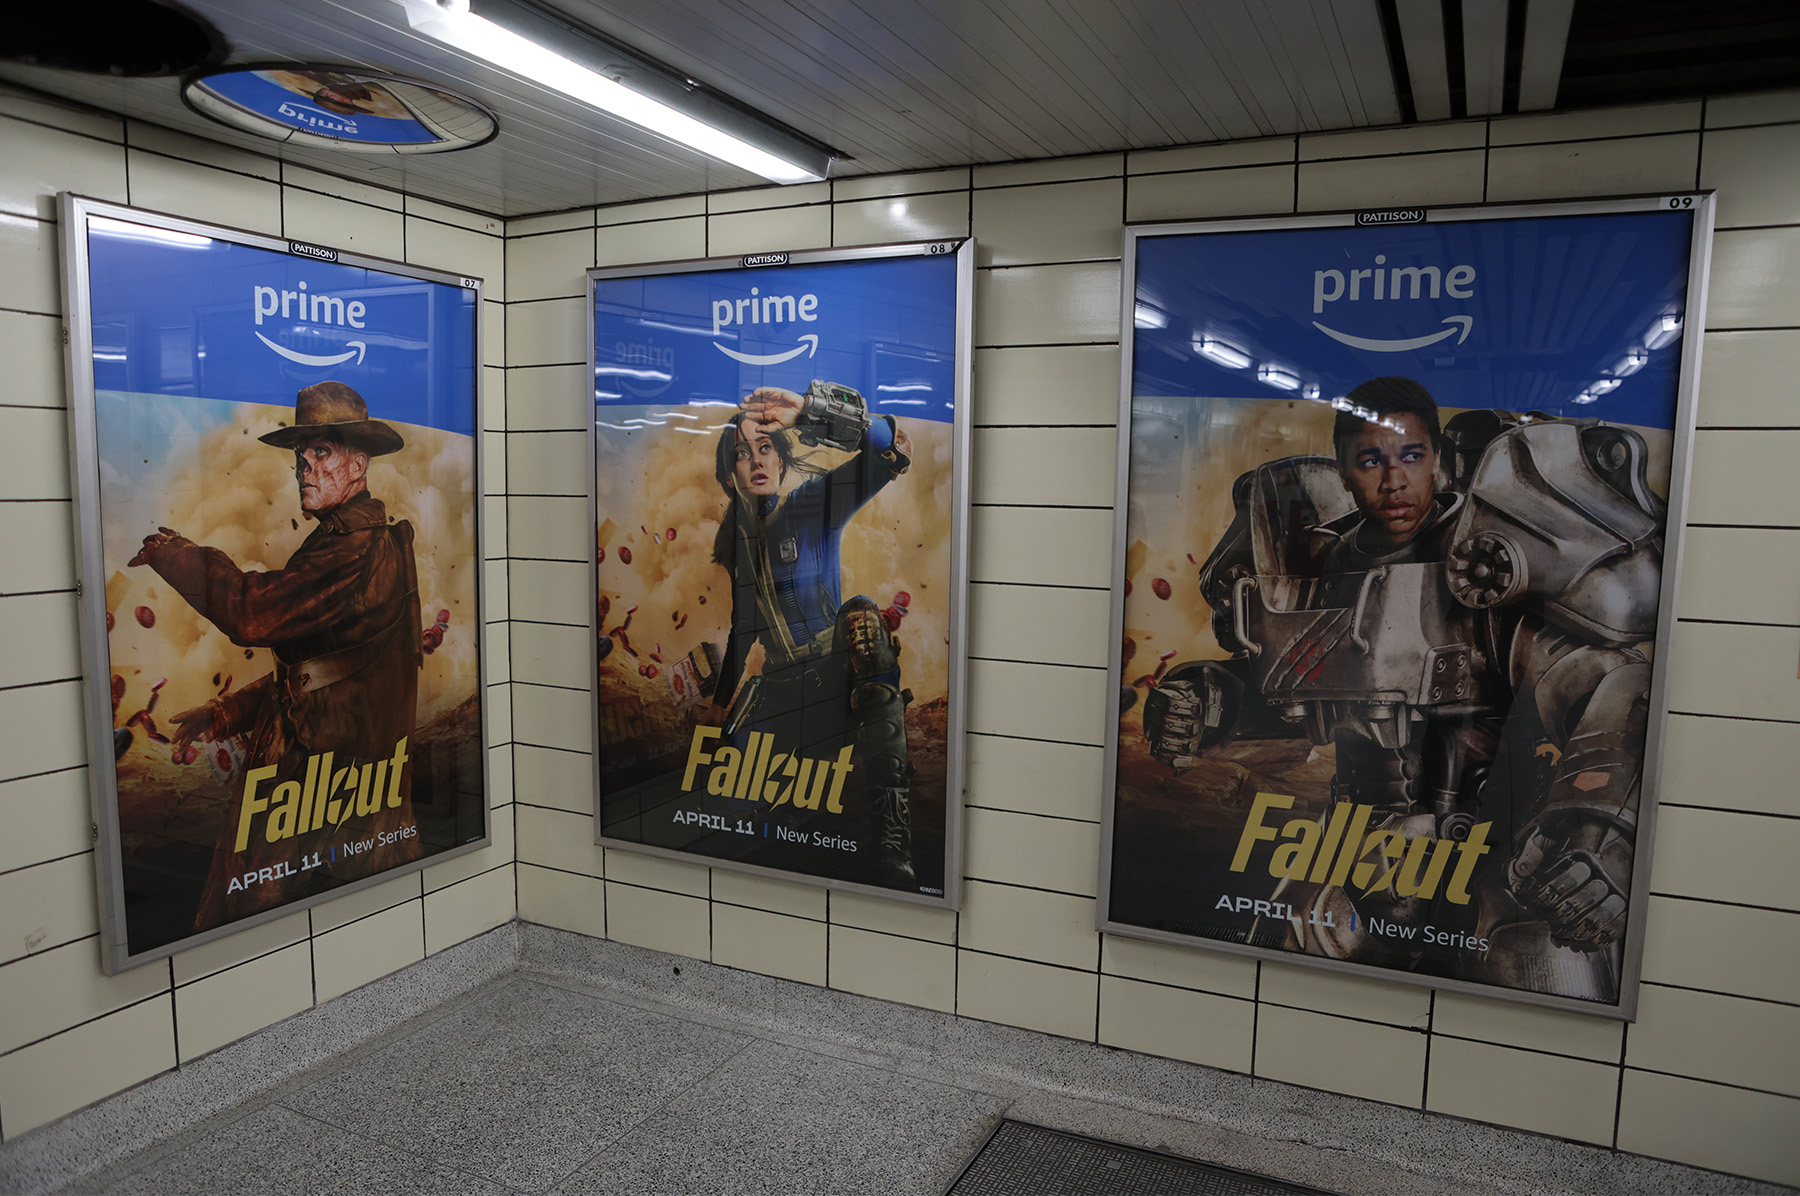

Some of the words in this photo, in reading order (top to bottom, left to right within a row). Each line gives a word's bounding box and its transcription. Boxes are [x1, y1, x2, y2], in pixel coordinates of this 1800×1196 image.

[1363, 210, 1418, 222] PATTISON
[1669, 197, 1693, 209] 09
[294, 243, 333, 259] PATTISON
[747, 254, 784, 265] PATTISON
[930, 244, 945, 254] 08
[465, 279, 476, 288] 07
[1313, 254, 1476, 313] prime
[254, 280, 366, 328] prime
[712, 287, 818, 335] prime
[680, 724, 855, 814] Fallout
[234, 735, 409, 853] Fallout
[672, 810, 732, 832] APRIL
[735, 819, 755, 835] 11
[776, 826, 808, 844] New
[812, 831, 857, 852] Series
[343, 838, 374, 858] New
[377, 823, 417, 847] Series
[1229, 792, 1492, 905] Fallout
[226, 862, 297, 895] APRIL
[301, 852, 322, 872] 11
[1214, 894, 1302, 922] APRIL
[1307, 909, 1337, 928] 11
[1369, 916, 1417, 940] New
[1422, 925, 1490, 952] Series
